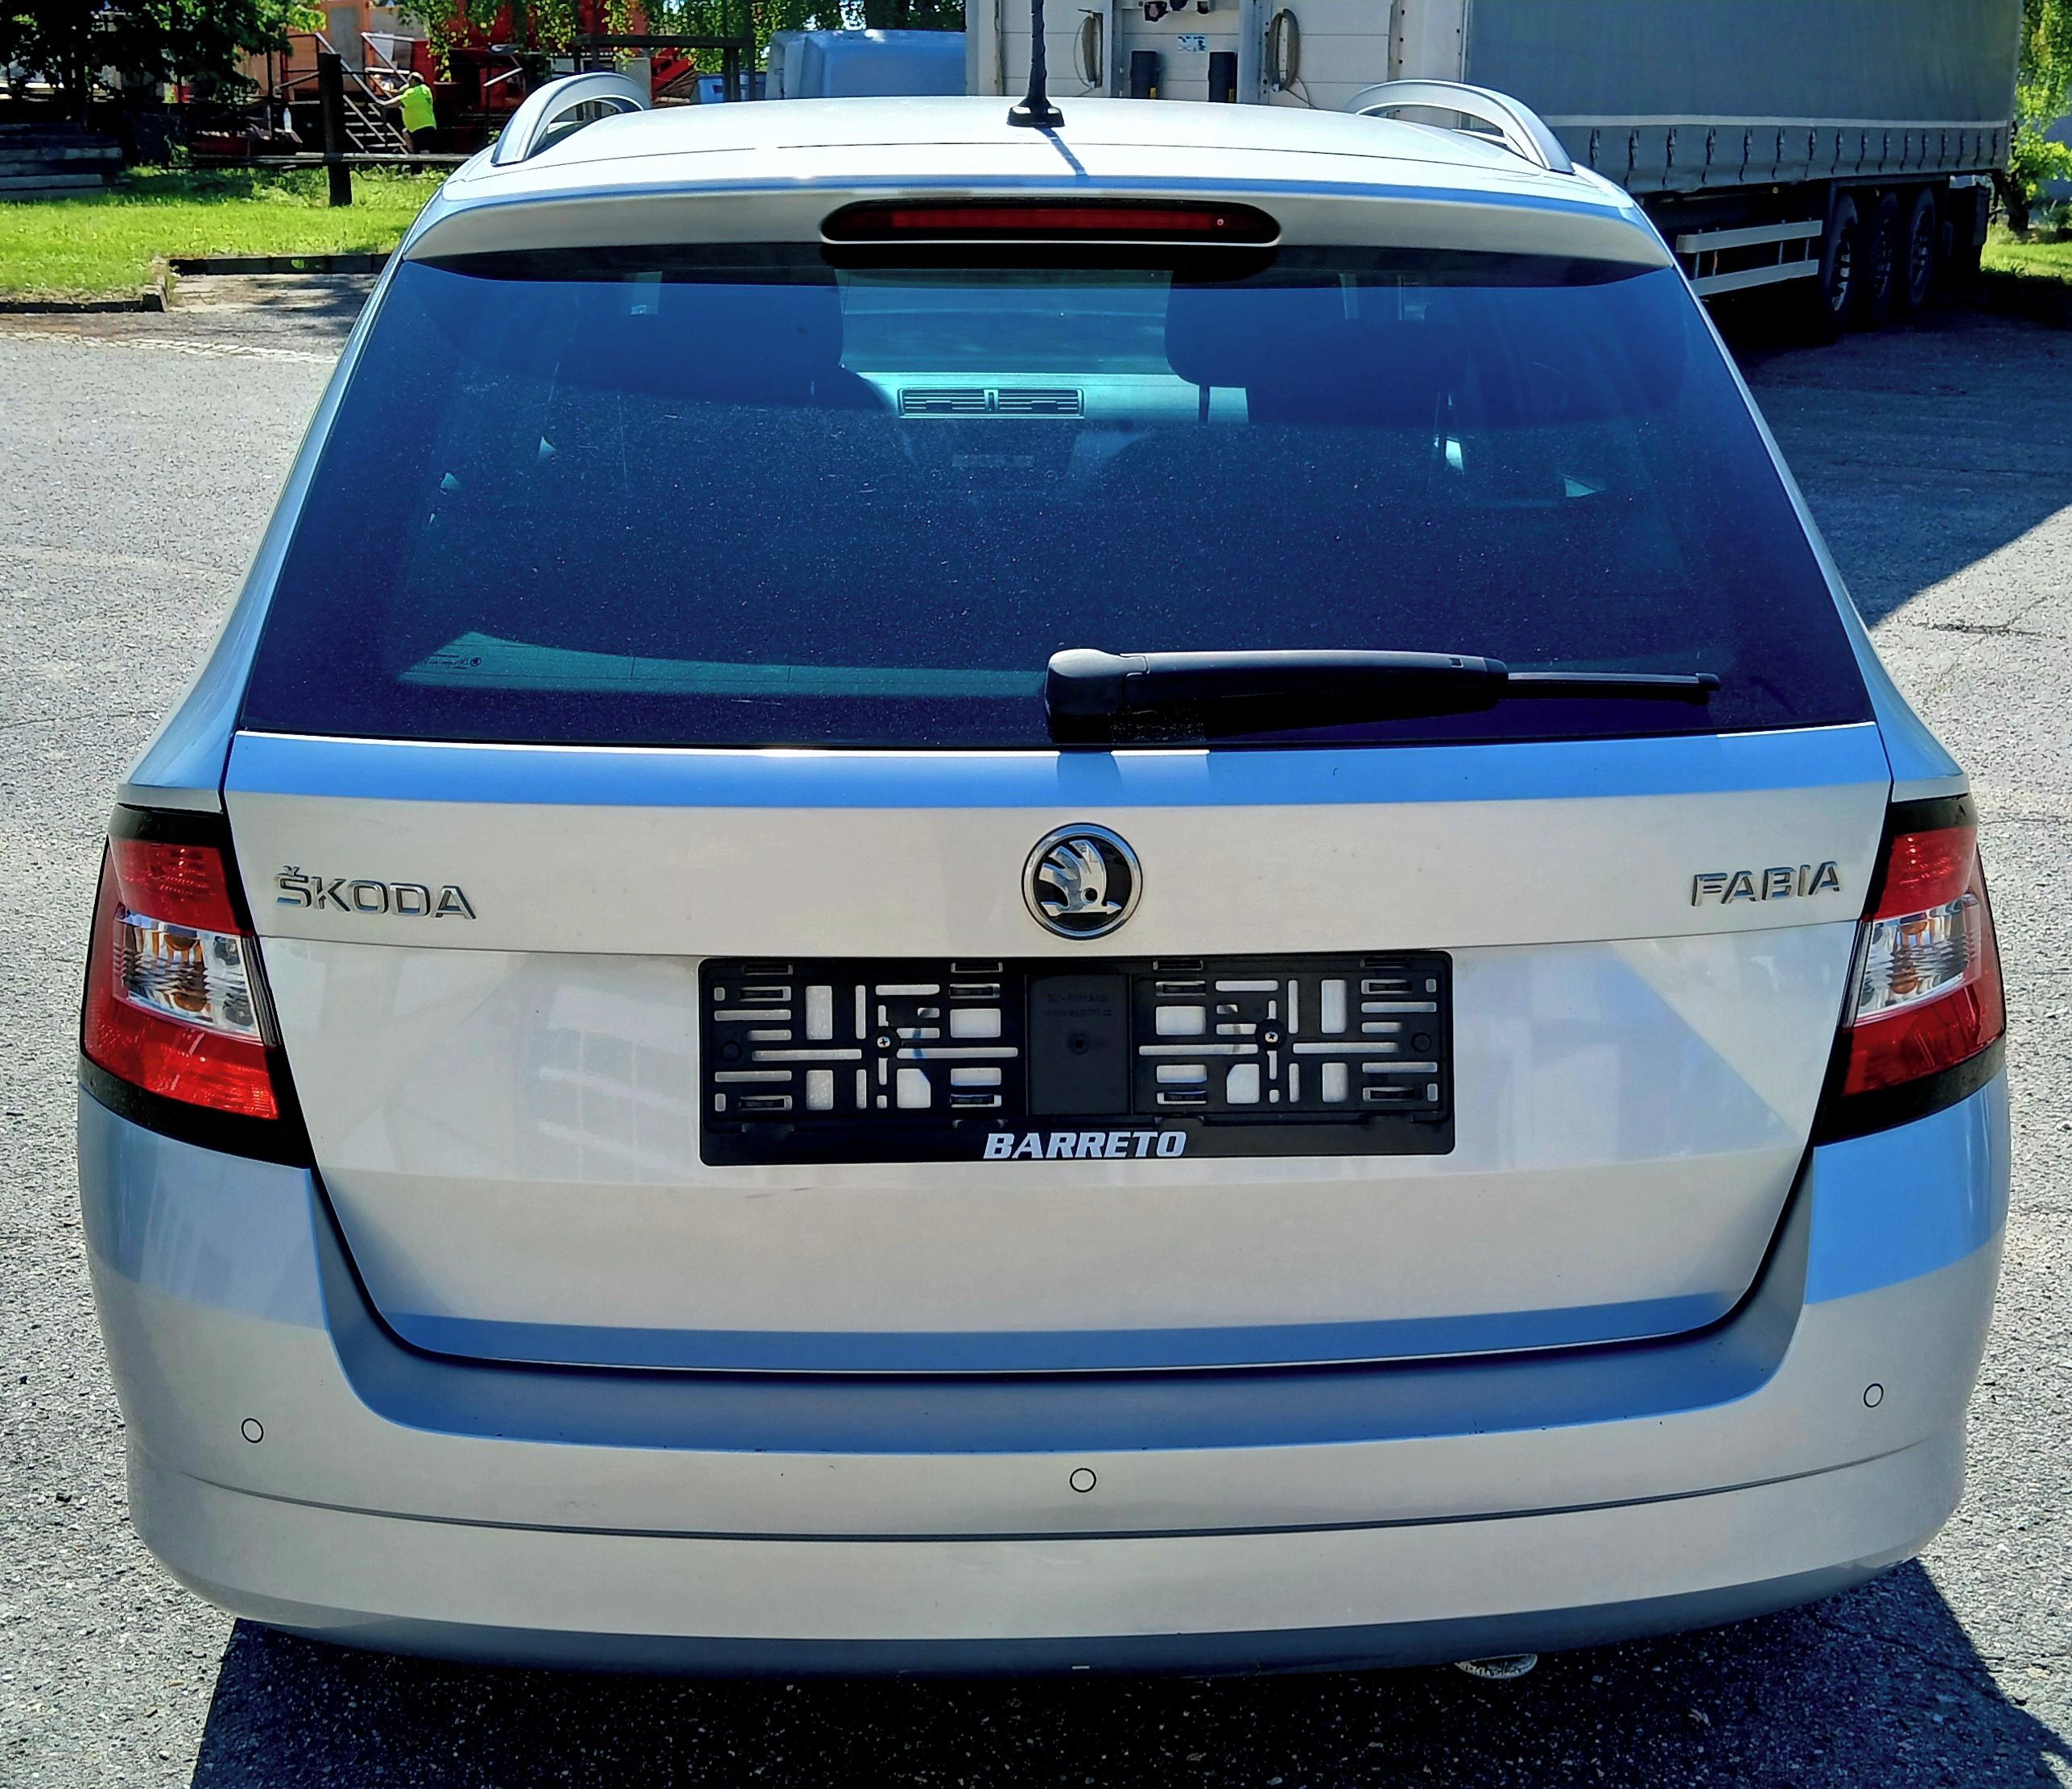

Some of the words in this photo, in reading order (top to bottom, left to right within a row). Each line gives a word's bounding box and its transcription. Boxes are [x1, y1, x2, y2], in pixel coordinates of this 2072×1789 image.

[274, 865, 477, 919] ŠKODA
[1690, 861, 1840, 907] FABIA
[983, 1131, 1187, 1159] BARRETO
